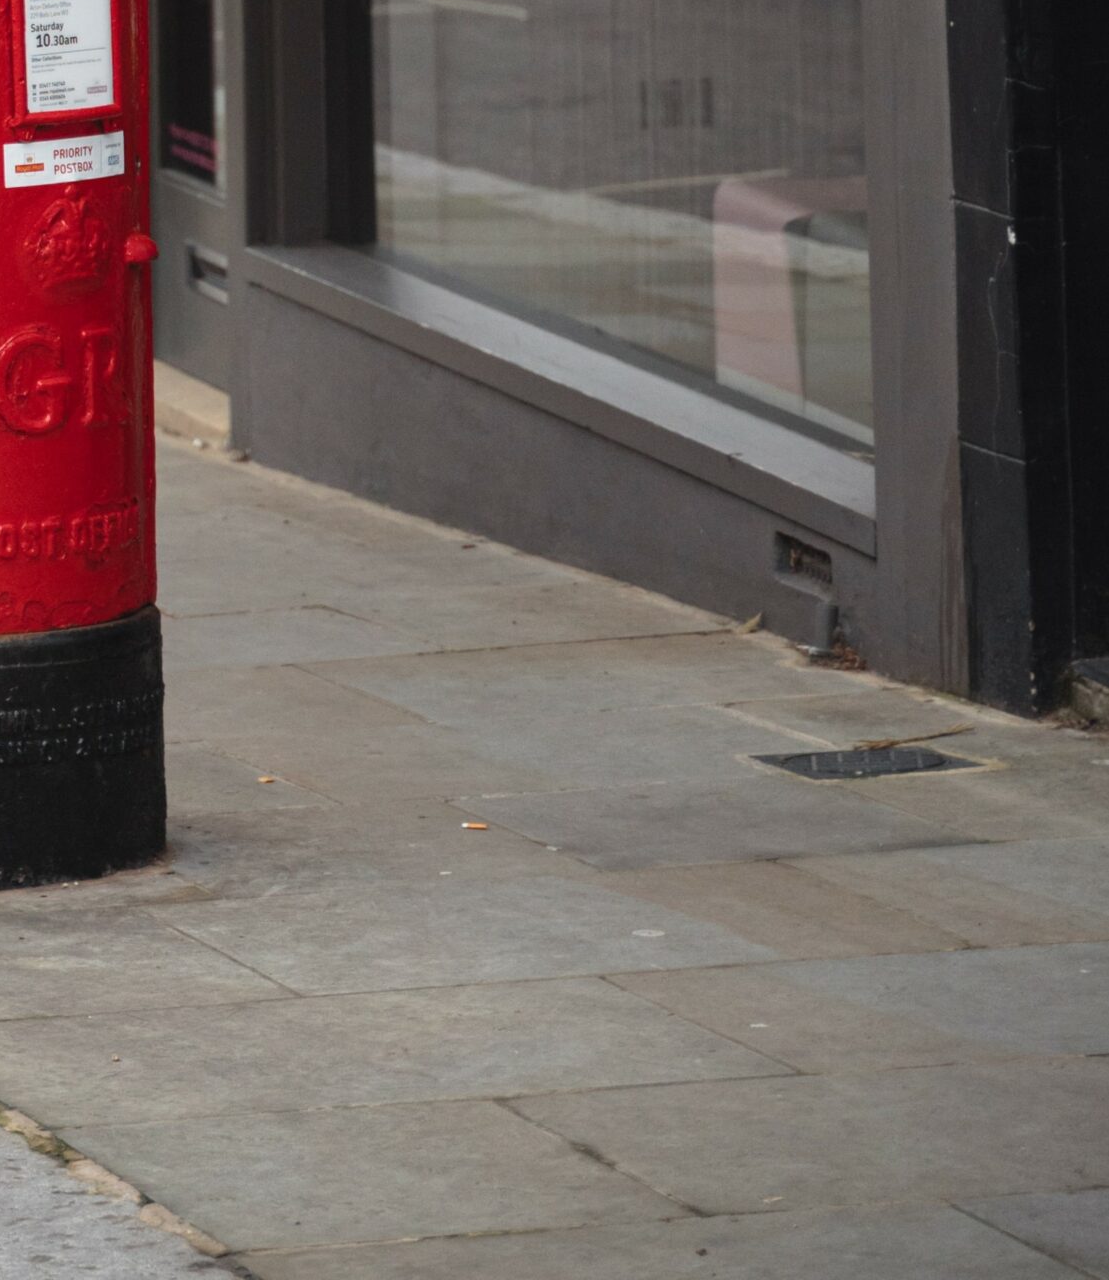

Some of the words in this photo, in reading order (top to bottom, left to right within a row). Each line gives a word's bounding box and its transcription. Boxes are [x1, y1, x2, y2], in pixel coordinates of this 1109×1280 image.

[30, 22, 64, 33] Saturday
[35, 33, 78, 48] 10.30am
[53, 145, 93, 160] PRIORITY
[53, 160, 93, 176] POSTBOX
